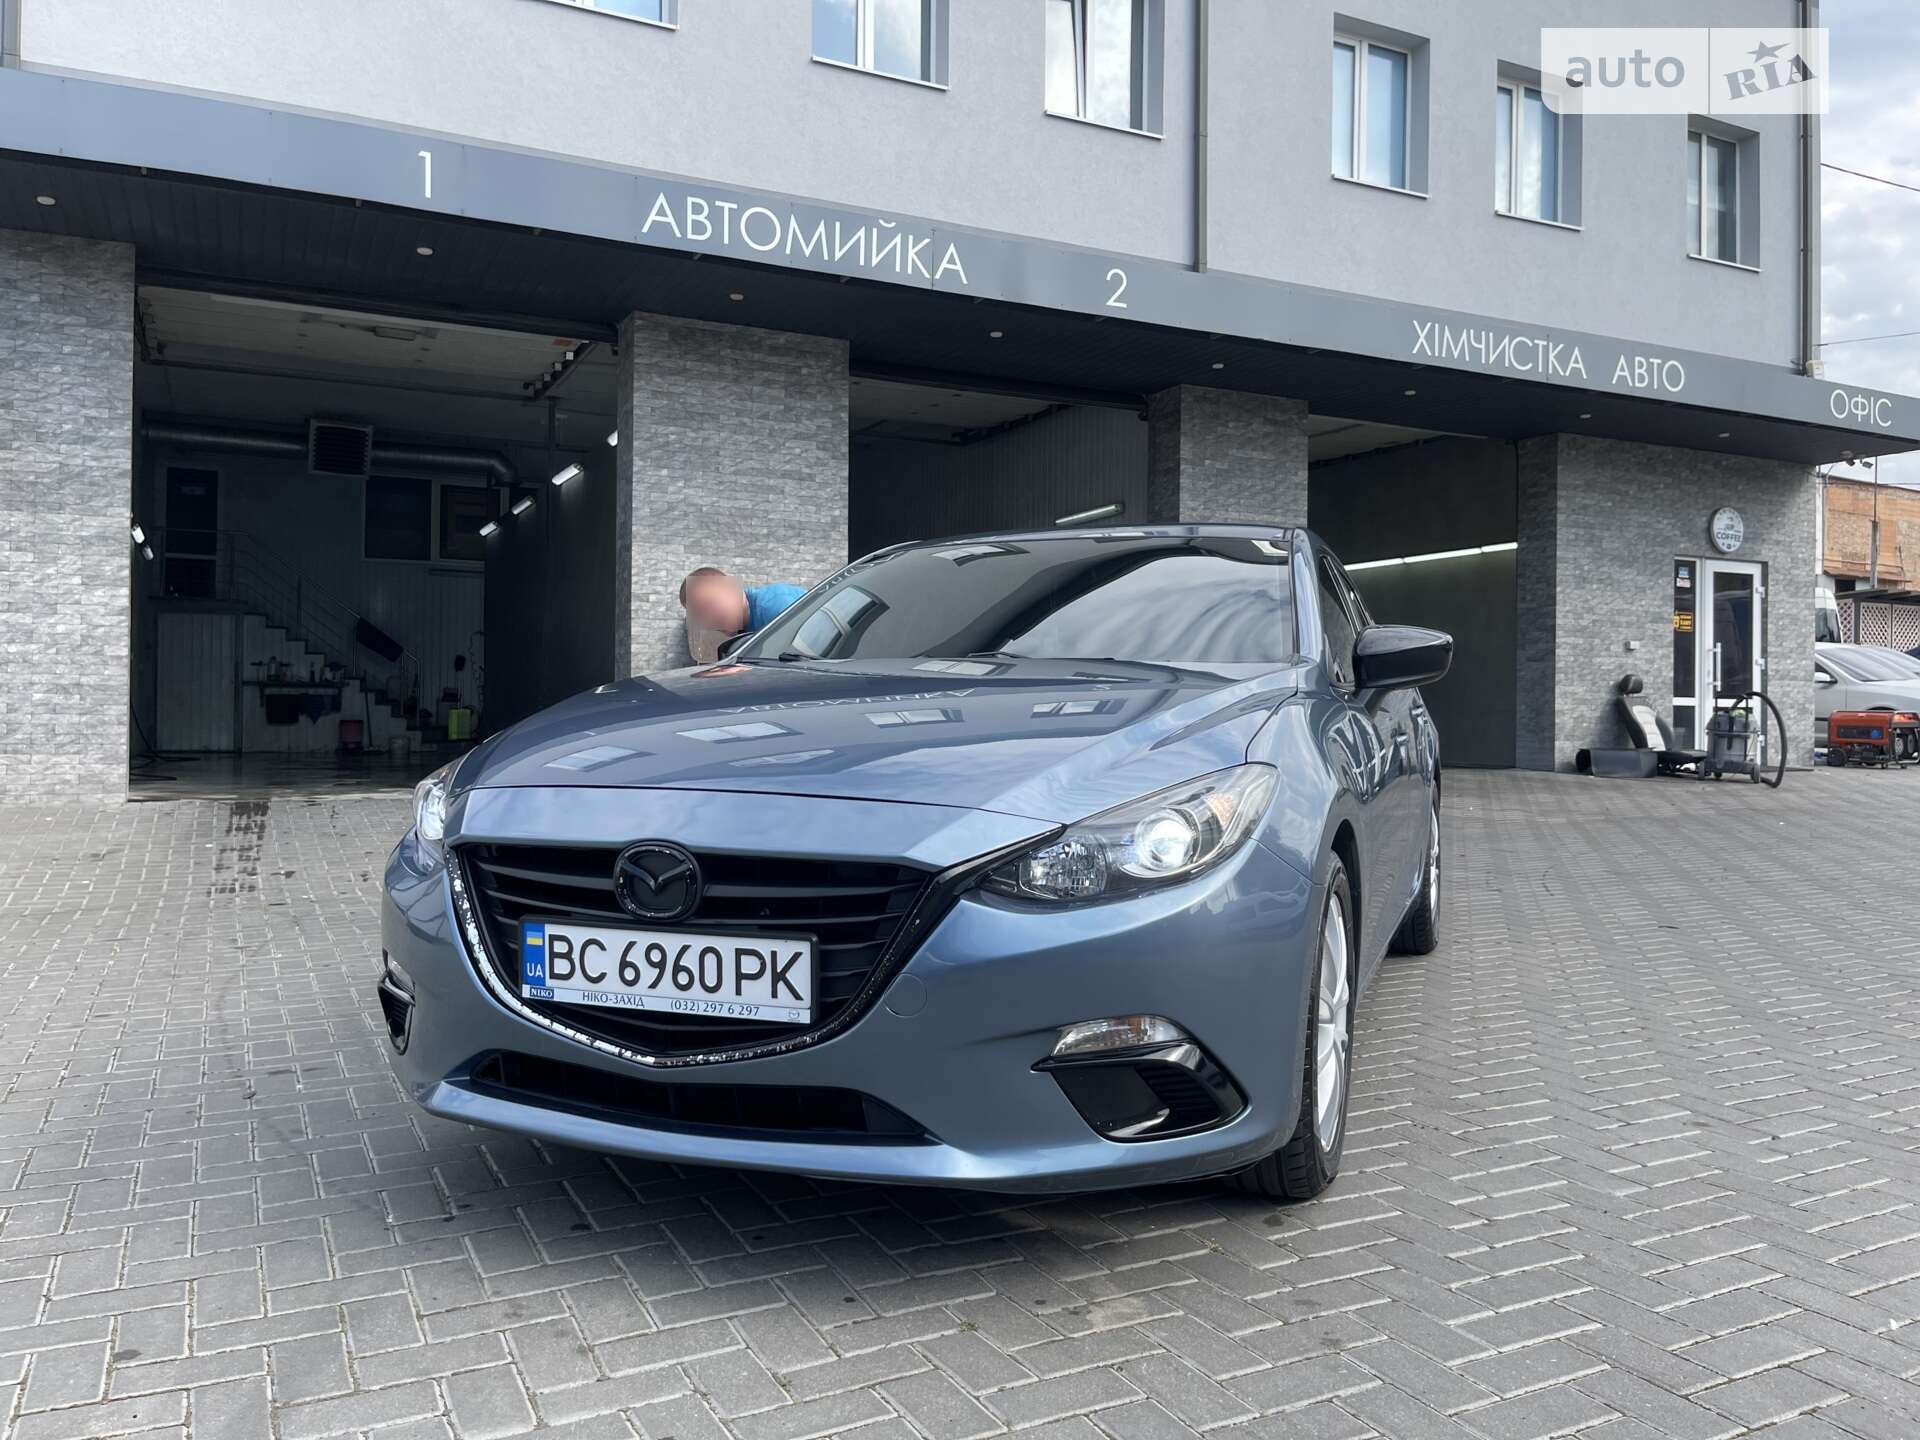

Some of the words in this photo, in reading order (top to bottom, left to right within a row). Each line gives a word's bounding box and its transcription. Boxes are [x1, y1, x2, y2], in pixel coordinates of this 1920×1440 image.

[417, 150, 432, 199] 1
[640, 192, 969, 285] АВТОМИЙКА
[1105, 268, 1128, 308] 2
[1412, 319, 1587, 379] ХІМЧИСТКА
[1612, 354, 1685, 393] АВТО
[1830, 389, 1892, 428] ОФІС
[527, 963, 544, 979] UA
[548, 933, 608, 985] BC
[618, 940, 723, 994] 6960
[734, 947, 804, 1001] PK
[530, 987, 553, 999] NIKO
[582, 991, 645, 1008] НІКО-ЗАХІД
[670, 1000, 700, 1013] (032)
[703, 1002, 724, 1013] 297
[727, 1004, 735, 1015] 6
[738, 1005, 760, 1017] 297
